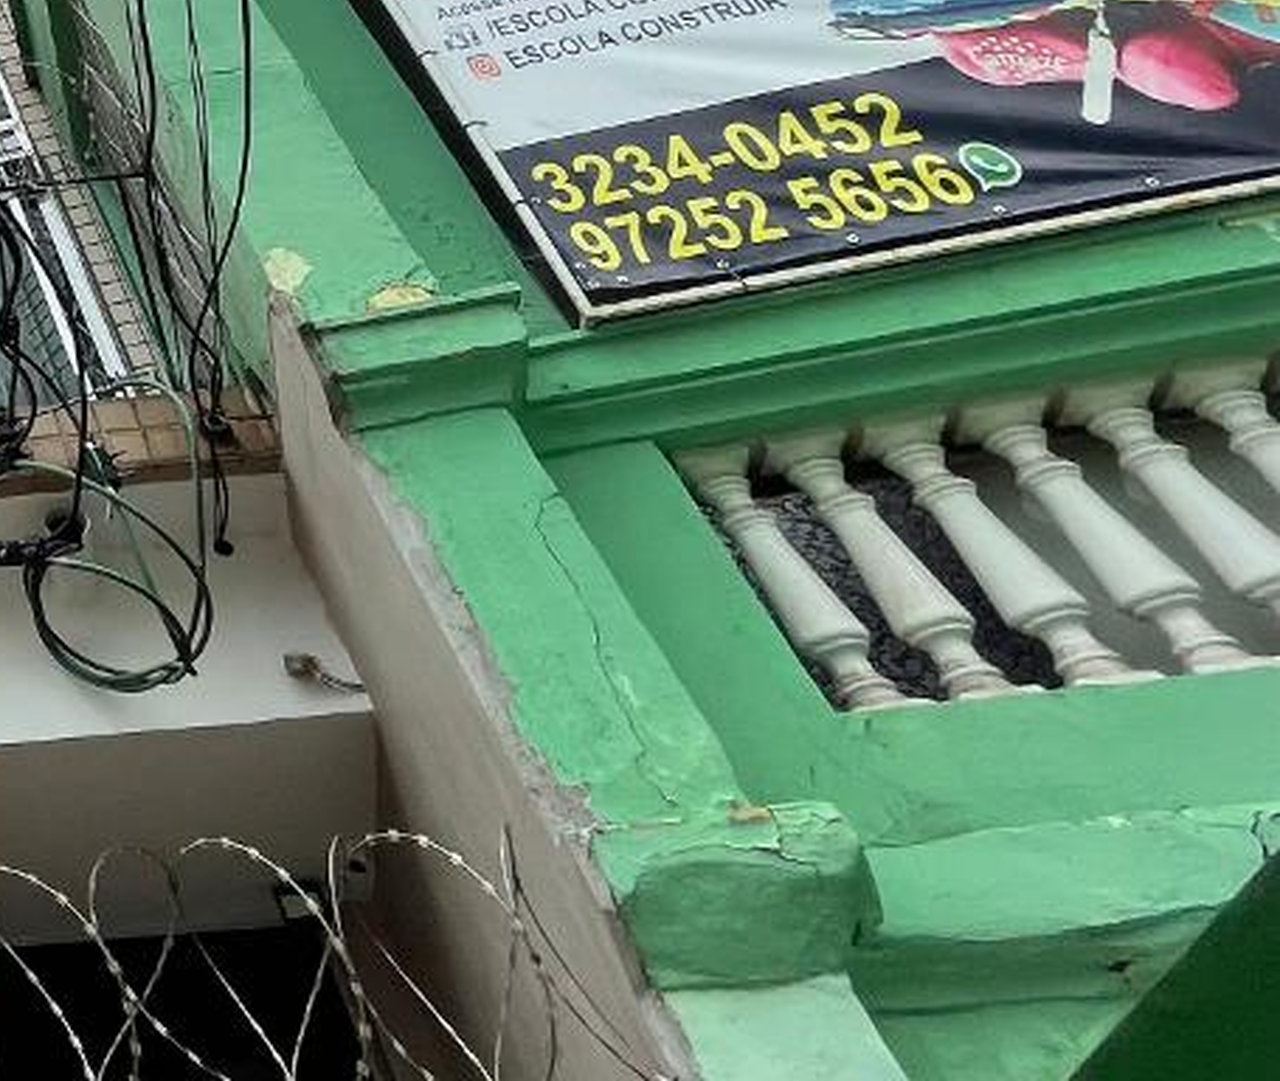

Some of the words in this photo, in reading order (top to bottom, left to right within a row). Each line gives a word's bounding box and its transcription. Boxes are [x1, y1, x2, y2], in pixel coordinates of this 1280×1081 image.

[503, 29, 620, 71] ESCOLA
[531, 92, 924, 214] 3234-0452
[569, 190, 790, 272] 97252
[786, 152, 977, 232] 5656
